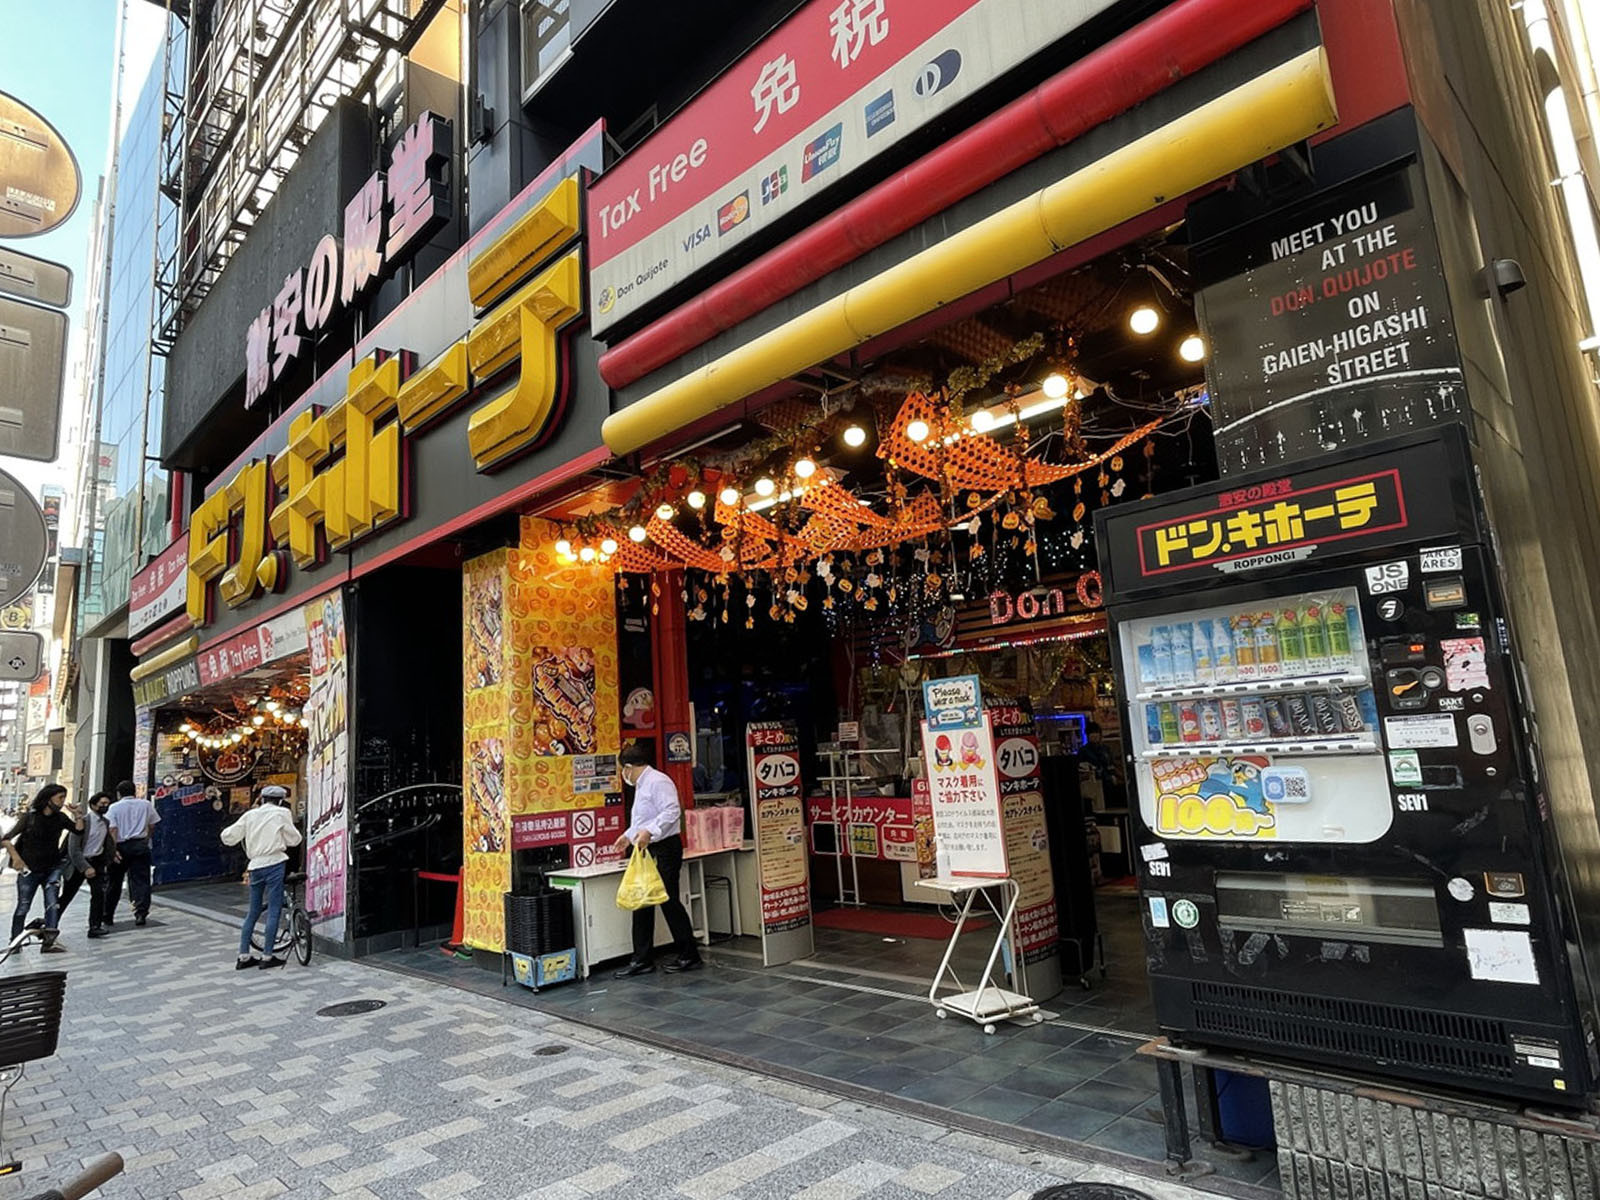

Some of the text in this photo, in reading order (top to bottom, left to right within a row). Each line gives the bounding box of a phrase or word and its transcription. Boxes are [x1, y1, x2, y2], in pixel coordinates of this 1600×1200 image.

[600, 138, 707, 238] Tax Free
[762, 169, 788, 200] JCB
[682, 224, 711, 253] VISA
[1271, 202, 1379, 260] MEET YOU
[1321, 224, 1398, 271] AT THE
[617, 259, 669, 299] Don Quijote
[1270, 249, 1417, 317] DON QUIJOTE
[1348, 291, 1381, 319] ON
[1263, 306, 1428, 375] GAIEN-HIGASHI
[1326, 341, 1411, 385] STREET
[1234, 551, 1296, 569] ROPPONGI
[1373, 564, 1404, 581] JS
[1422, 558, 1456, 569] ARES
[1371, 578, 1409, 593] ONE
[989, 588, 1065, 625] Don
[1342, 699, 1361, 729] BOSS
[760, 762, 796, 780] タバコ
[1000, 747, 1035, 770] タバコ
[810, 803, 908, 824] サービスカウンター
